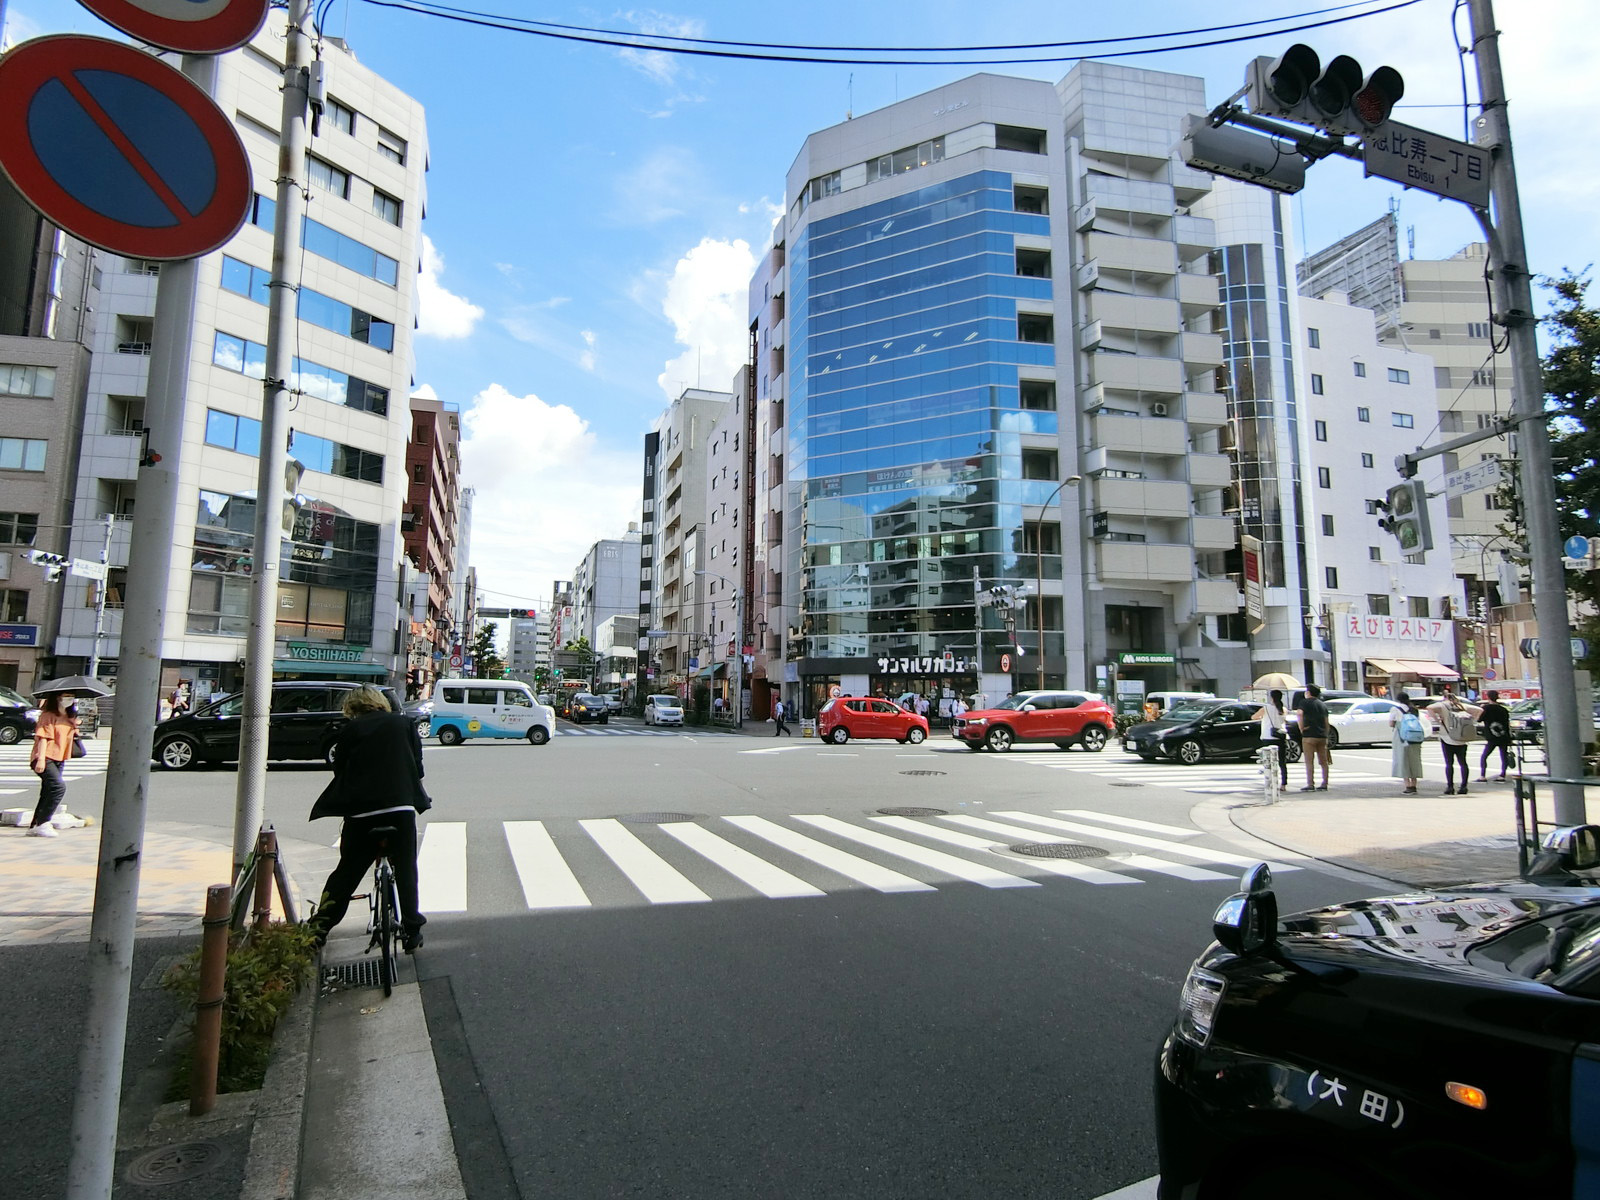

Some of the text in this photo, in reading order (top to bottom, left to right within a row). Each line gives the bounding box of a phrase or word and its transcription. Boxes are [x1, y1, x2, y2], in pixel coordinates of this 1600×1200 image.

[1408, 164, 1449, 189] Ebisu 1
[1350, 616, 1442, 639] えびすストア
[292, 647, 363, 661] YOSHIHARA
